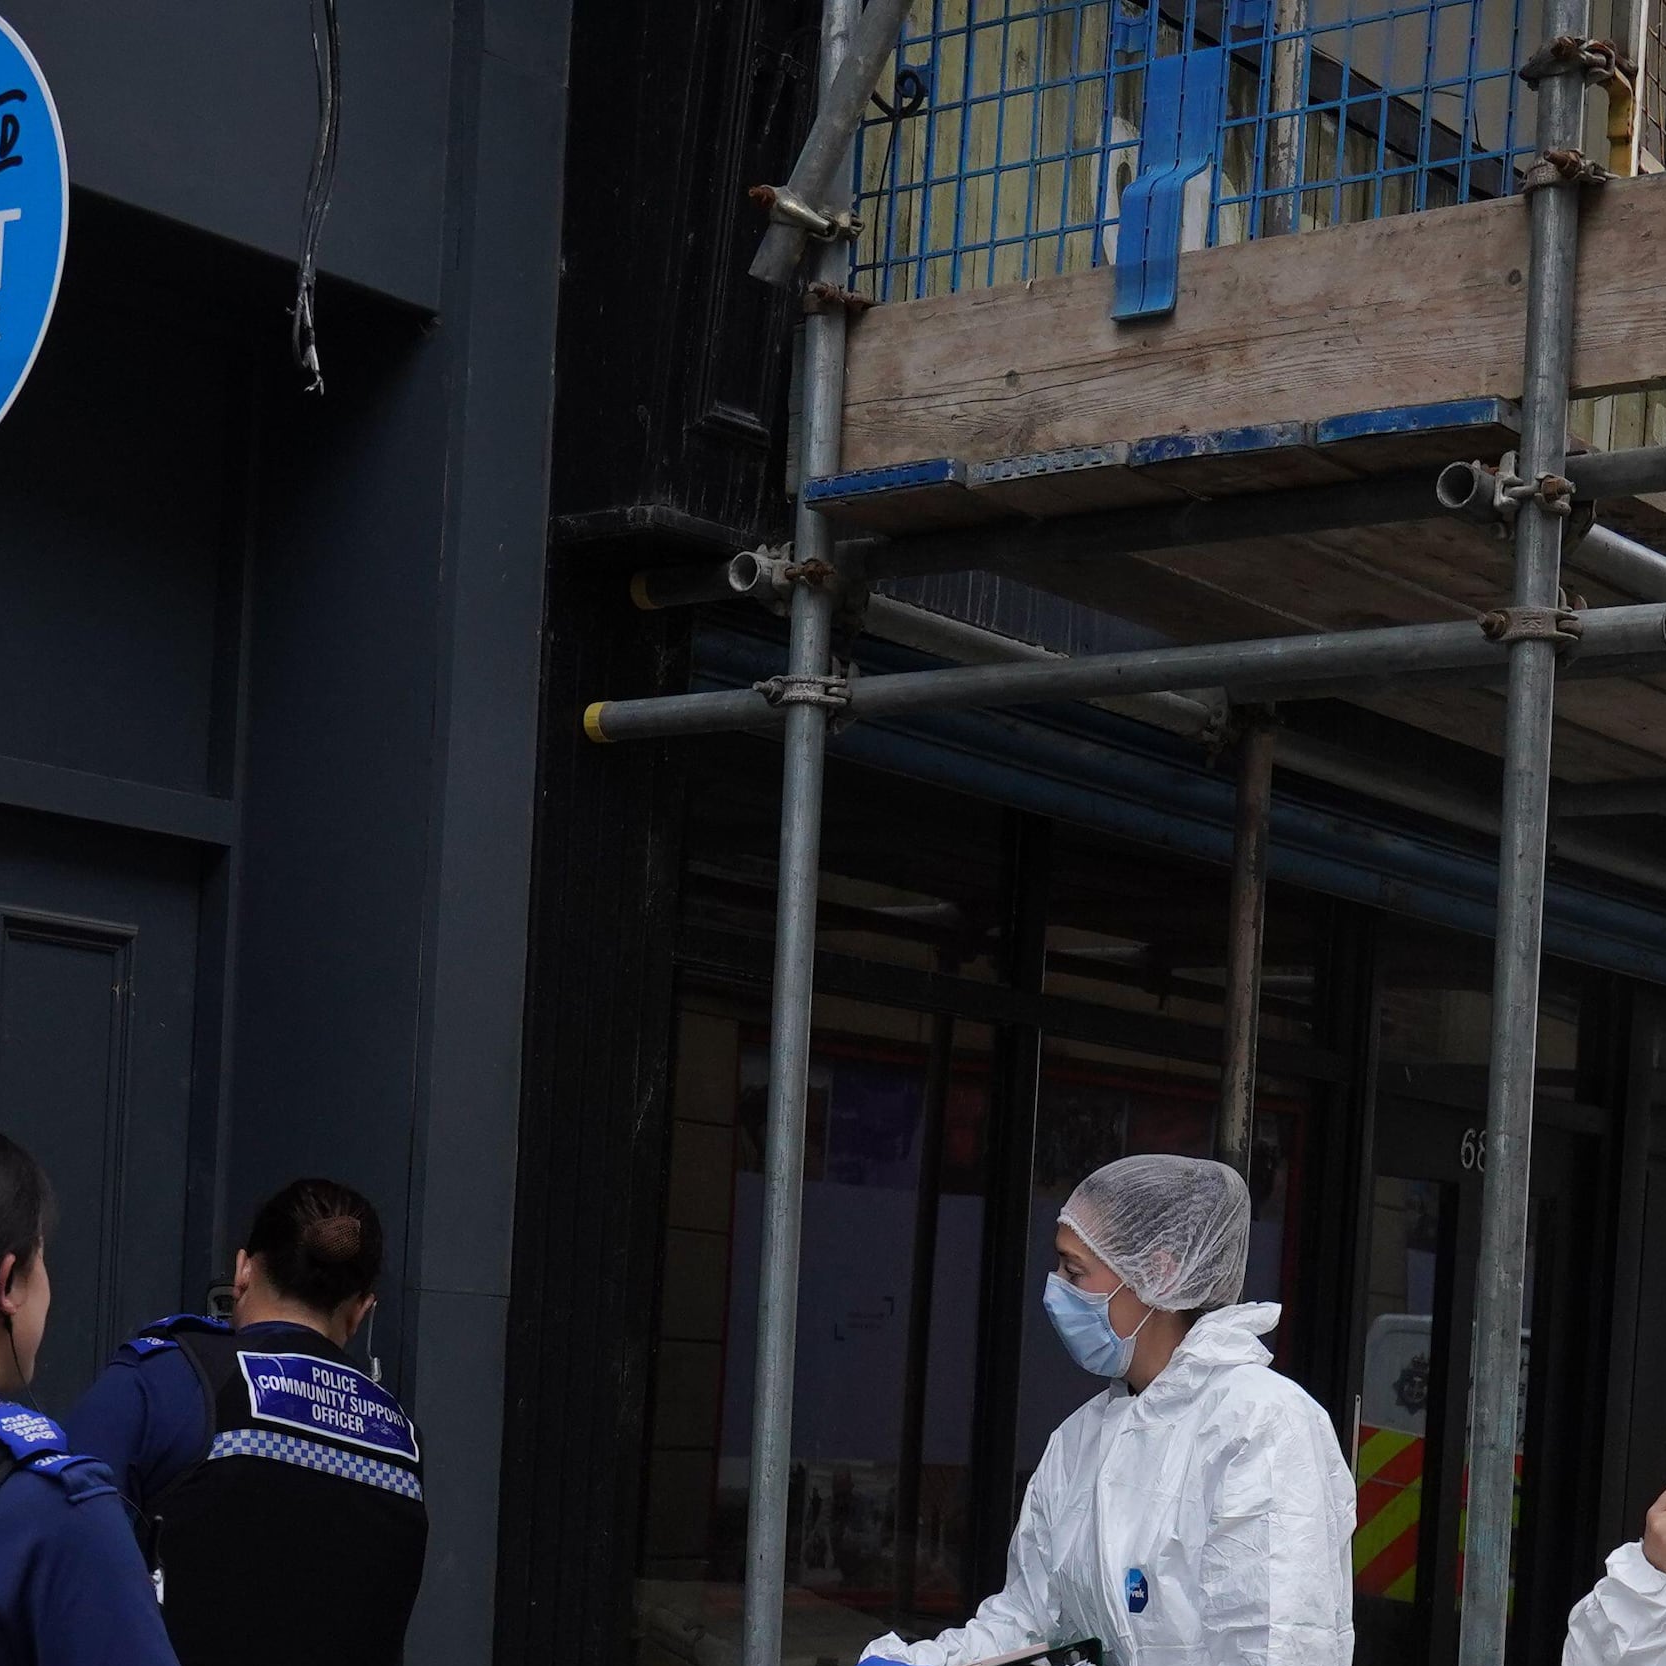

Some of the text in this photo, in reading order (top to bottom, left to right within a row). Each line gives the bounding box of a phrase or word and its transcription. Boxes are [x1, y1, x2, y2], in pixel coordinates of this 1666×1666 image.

[312, 1367, 358, 1394] POLICE
[258, 1374, 406, 1428] COMMUNITY SUPPORT
[312, 1404, 364, 1433] OFFICER
